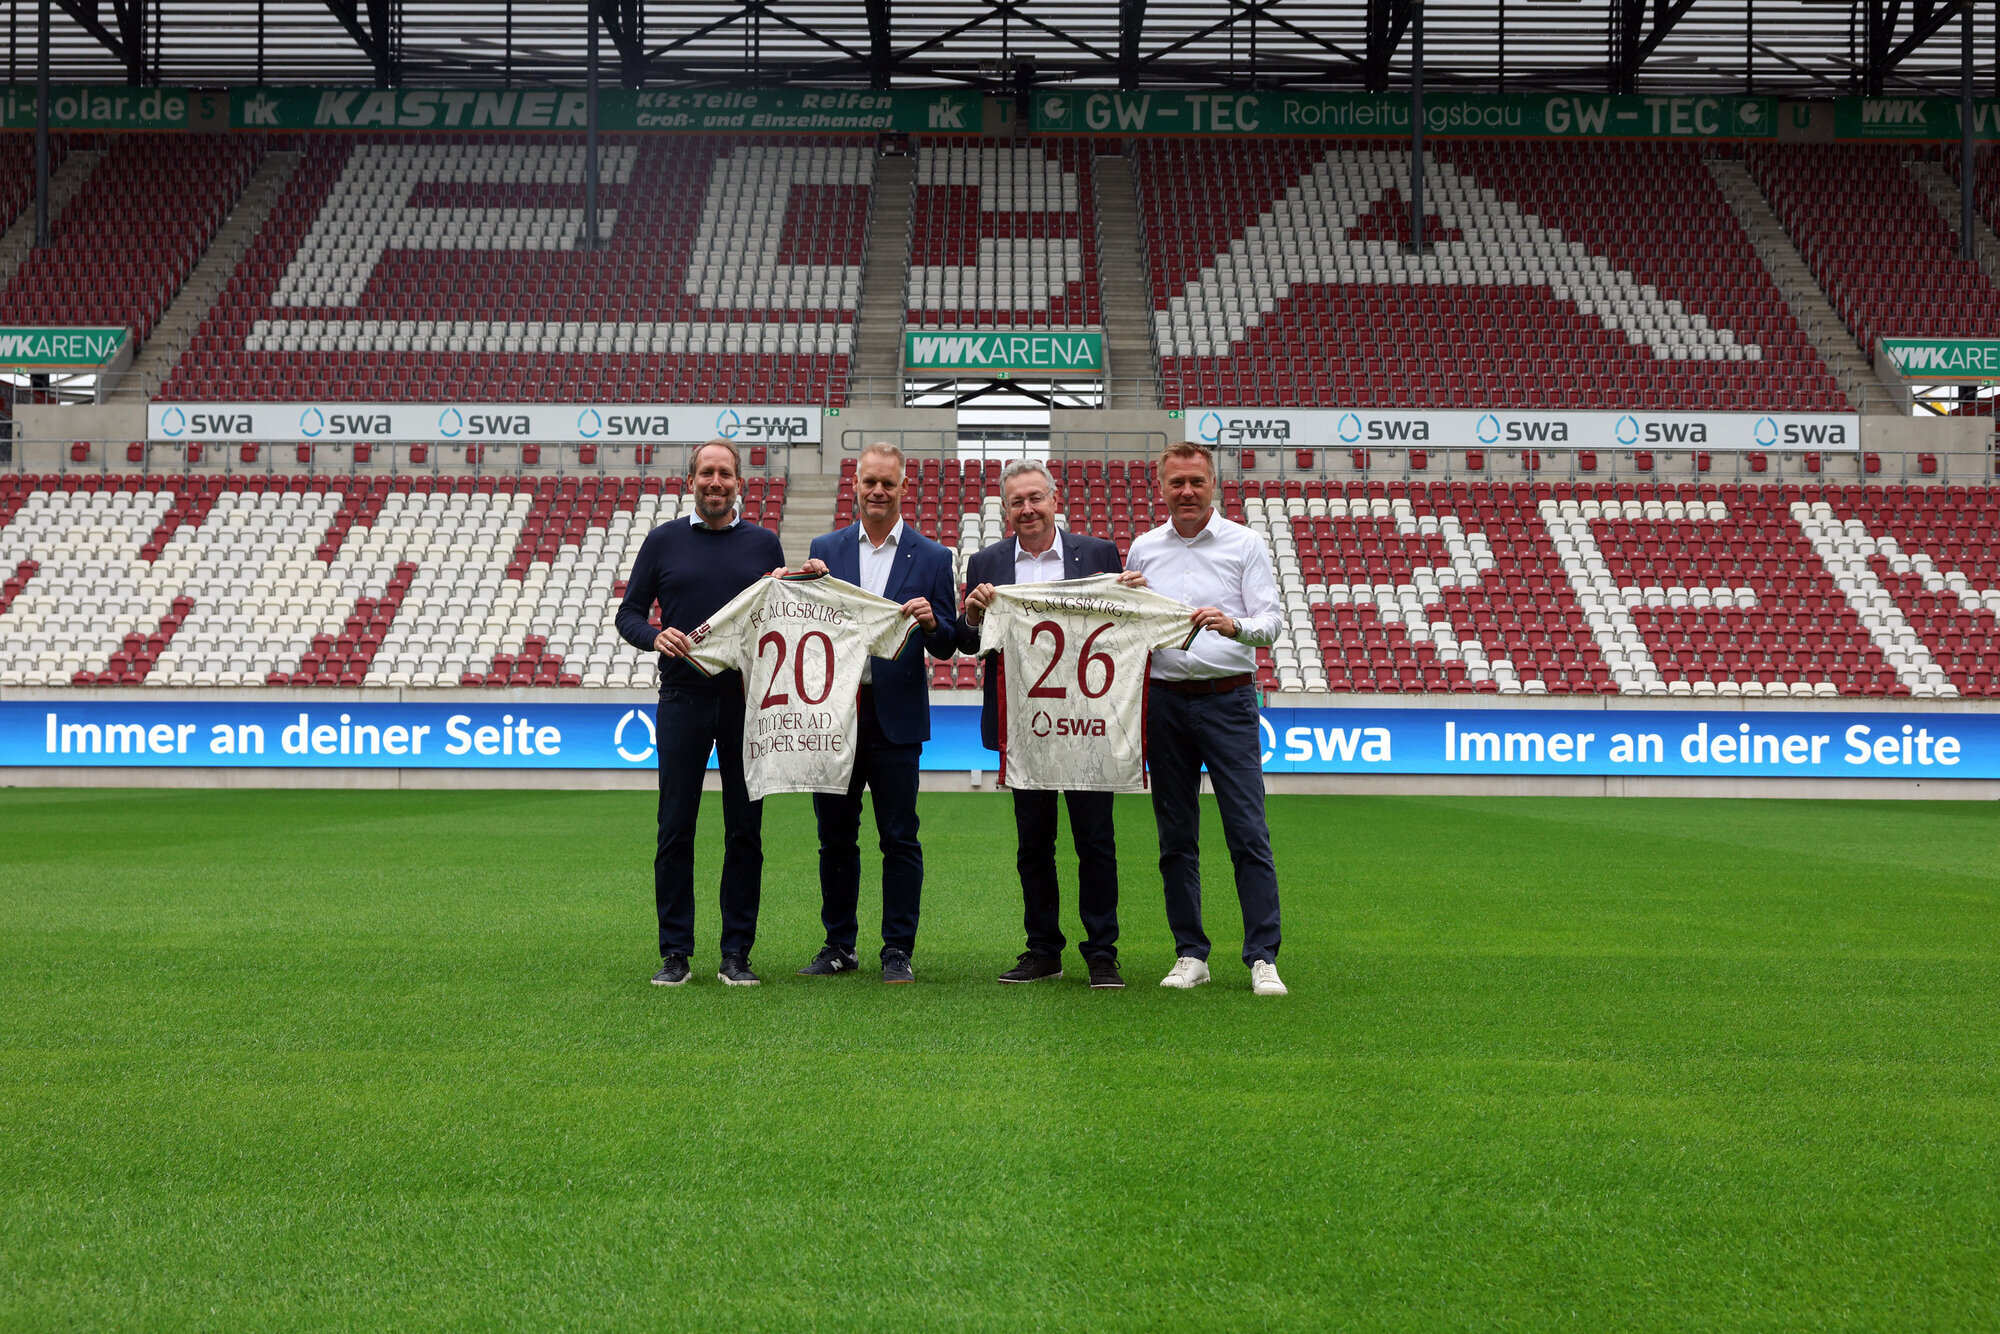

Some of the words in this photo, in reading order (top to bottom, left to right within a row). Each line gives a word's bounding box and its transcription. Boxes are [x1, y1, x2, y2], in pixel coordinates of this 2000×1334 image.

[0, 89, 185, 126] i-solar.de
[314, 90, 588, 126] KASTNER
[637, 93, 758, 109] Kfz-Teile
[801, 93, 892, 109] Reifen
[996, 99, 1012, 122] T
[1862, 99, 1927, 123] WWK
[703, 113, 743, 128] und
[750, 112, 893, 129] Einzelhandel
[1283, 99, 1521, 132] Rohrleitugsbau
[1793, 104, 1810, 128] U
[191, 414, 253, 434] swa
[330, 414, 392, 435] swa
[468, 415, 530, 435] swa
[607, 415, 669, 436] swa
[746, 416, 808, 437] swa
[1229, 419, 1291, 440] swa
[1367, 420, 1430, 441] swa
[1506, 421, 1568, 441] swa
[1645, 422, 1707, 443] swa
[1784, 423, 1846, 444] swa
[750, 607, 766, 629] FC
[768, 601, 845, 626] AUGSBURG
[1021, 600, 1043, 617] FC
[1044, 597, 1125, 618] AUGSBURG
[758, 630, 834, 710] 20
[1027, 620, 1115, 699] 26
[808, 712, 832, 730] AN
[1056, 718, 1106, 737] swa
[46, 713, 197, 753] Immer
[210, 723, 265, 754] an
[281, 713, 430, 755] deiner
[444, 714, 562, 756] Seite
[797, 734, 842, 752] SEITE
[1285, 726, 1392, 762] swa
[1445, 721, 1595, 762] Immer
[1608, 732, 1664, 763] an
[1681, 722, 1830, 764] deiner
[1844, 723, 1962, 766] Seite
